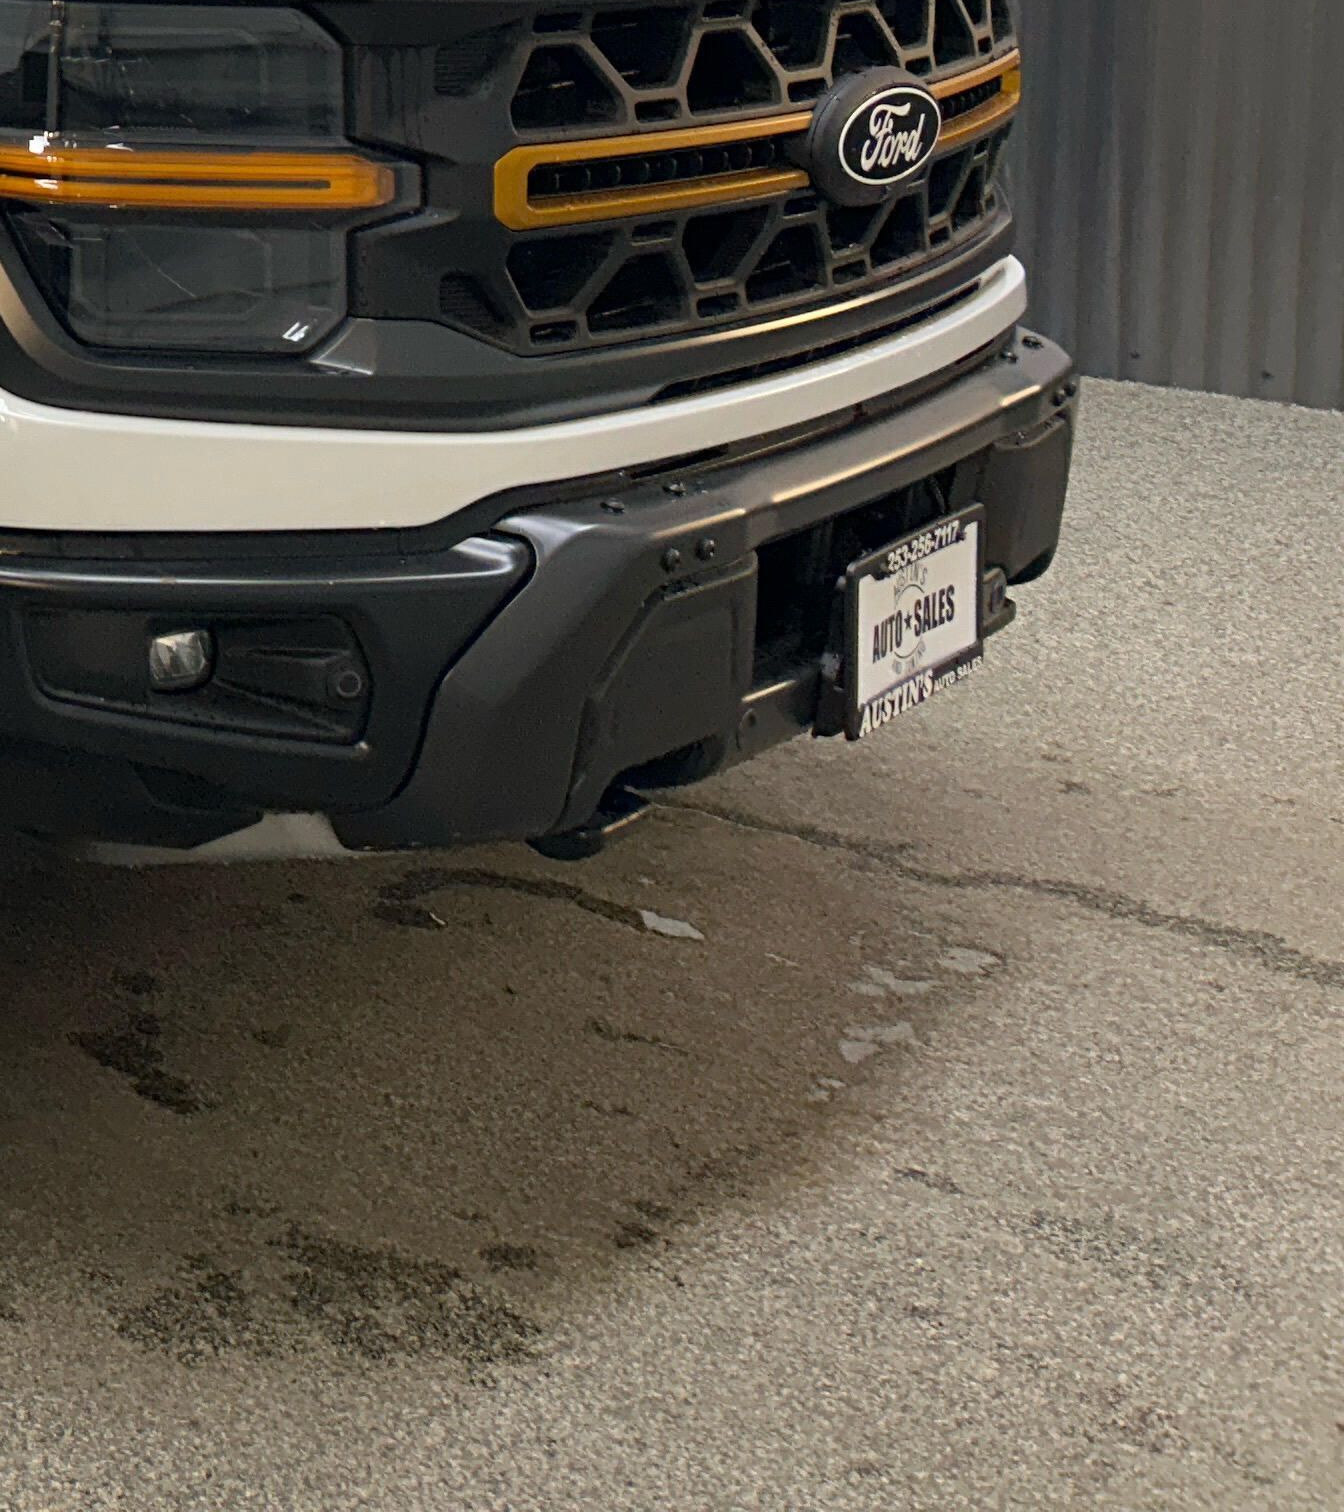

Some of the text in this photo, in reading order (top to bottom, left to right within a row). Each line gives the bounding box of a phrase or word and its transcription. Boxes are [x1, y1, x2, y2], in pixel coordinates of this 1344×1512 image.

[860, 102, 925, 172] Ford
[872, 609, 903, 663] AUTO
[914, 584, 955, 637] SALES
[859, 669, 933, 737] AUSTIN'S
